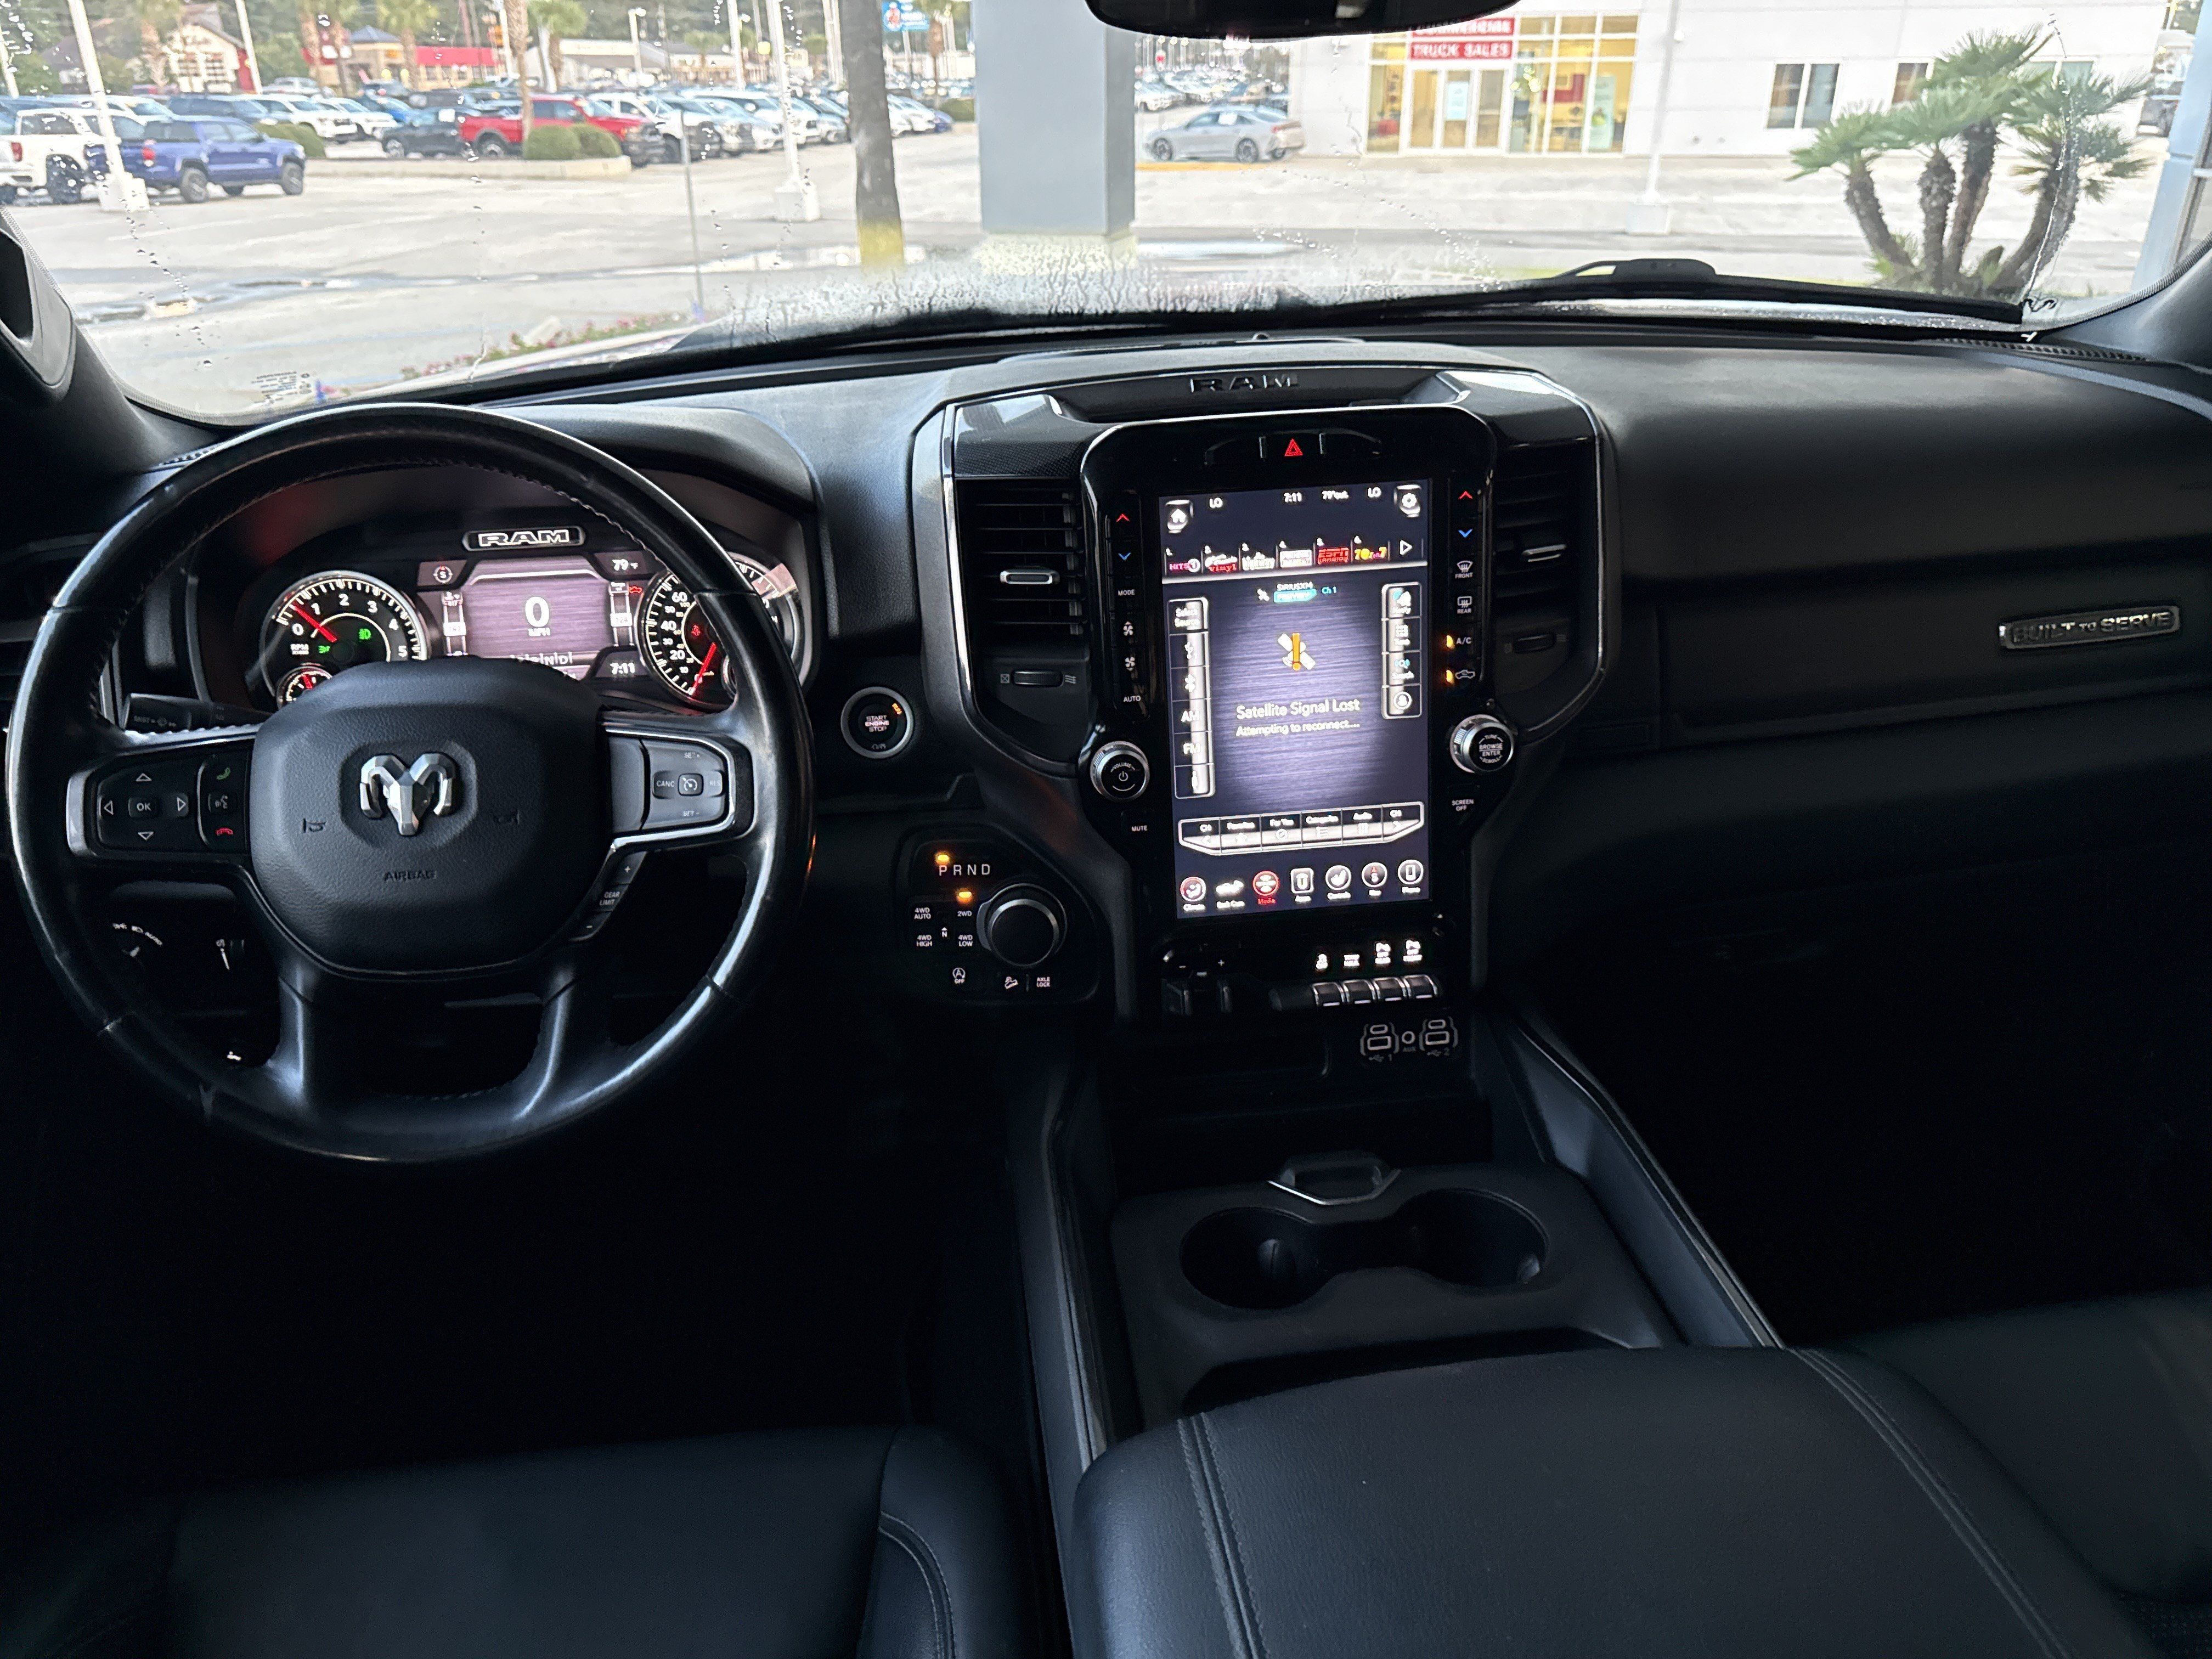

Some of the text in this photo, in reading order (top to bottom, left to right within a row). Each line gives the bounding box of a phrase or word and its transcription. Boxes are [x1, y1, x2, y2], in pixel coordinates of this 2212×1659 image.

[1413, 42, 1509, 57] TRUCK SALES
[1189, 374, 1300, 393] RAM
[1284, 492, 1302, 503] 7:11
[1368, 487, 1382, 498] LO
[1209, 497, 1223, 509] LO
[478, 529, 570, 548] RAM
[1208, 563, 1237, 572] vinyl
[338, 594, 349, 606] 2
[672, 591, 687, 602] 60
[311, 603, 320, 614] 1
[368, 601, 378, 613] 3
[525, 596, 549, 627] 0
[389, 618, 399, 630] 4
[661, 620, 676, 631] 40
[2101, 612, 2171, 632] SERVE
[292, 623, 303, 635] 0
[398, 645, 408, 657] 5
[670, 650, 685, 660] 20
[610, 663, 635, 674] 7:11
[1236, 698, 1360, 720] Satellite Signal Lost
[1181, 710, 1200, 723] AM
[1235, 724, 1289, 736] Attempting
[1290, 723, 1301, 732] to
[1183, 743, 1201, 755] FM
[137, 802, 151, 811] OK
[939, 864, 990, 876] P R N D
